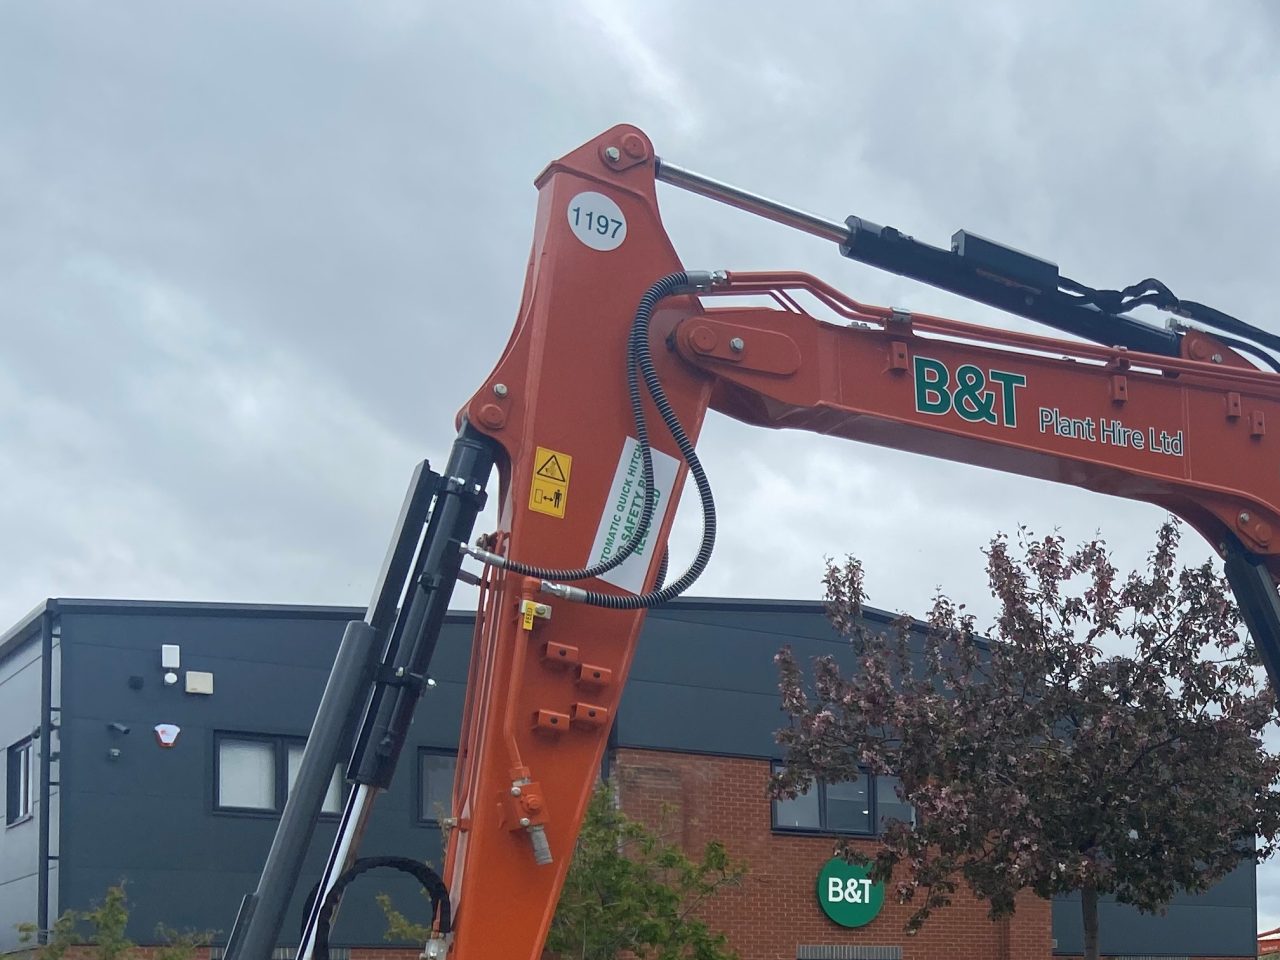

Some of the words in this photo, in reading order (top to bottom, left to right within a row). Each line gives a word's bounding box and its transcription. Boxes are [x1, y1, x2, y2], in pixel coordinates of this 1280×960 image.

[573, 207, 622, 238] 1197
[913, 355, 1026, 428] B&T
[1039, 407, 1095, 441] Plant
[1100, 419, 1144, 449] Hire
[1149, 427, 1183, 457] Ltd
[616, 478, 634, 512] QUICK
[621, 491, 645, 541] SAFETY
[828, 876, 872, 903] B&T
